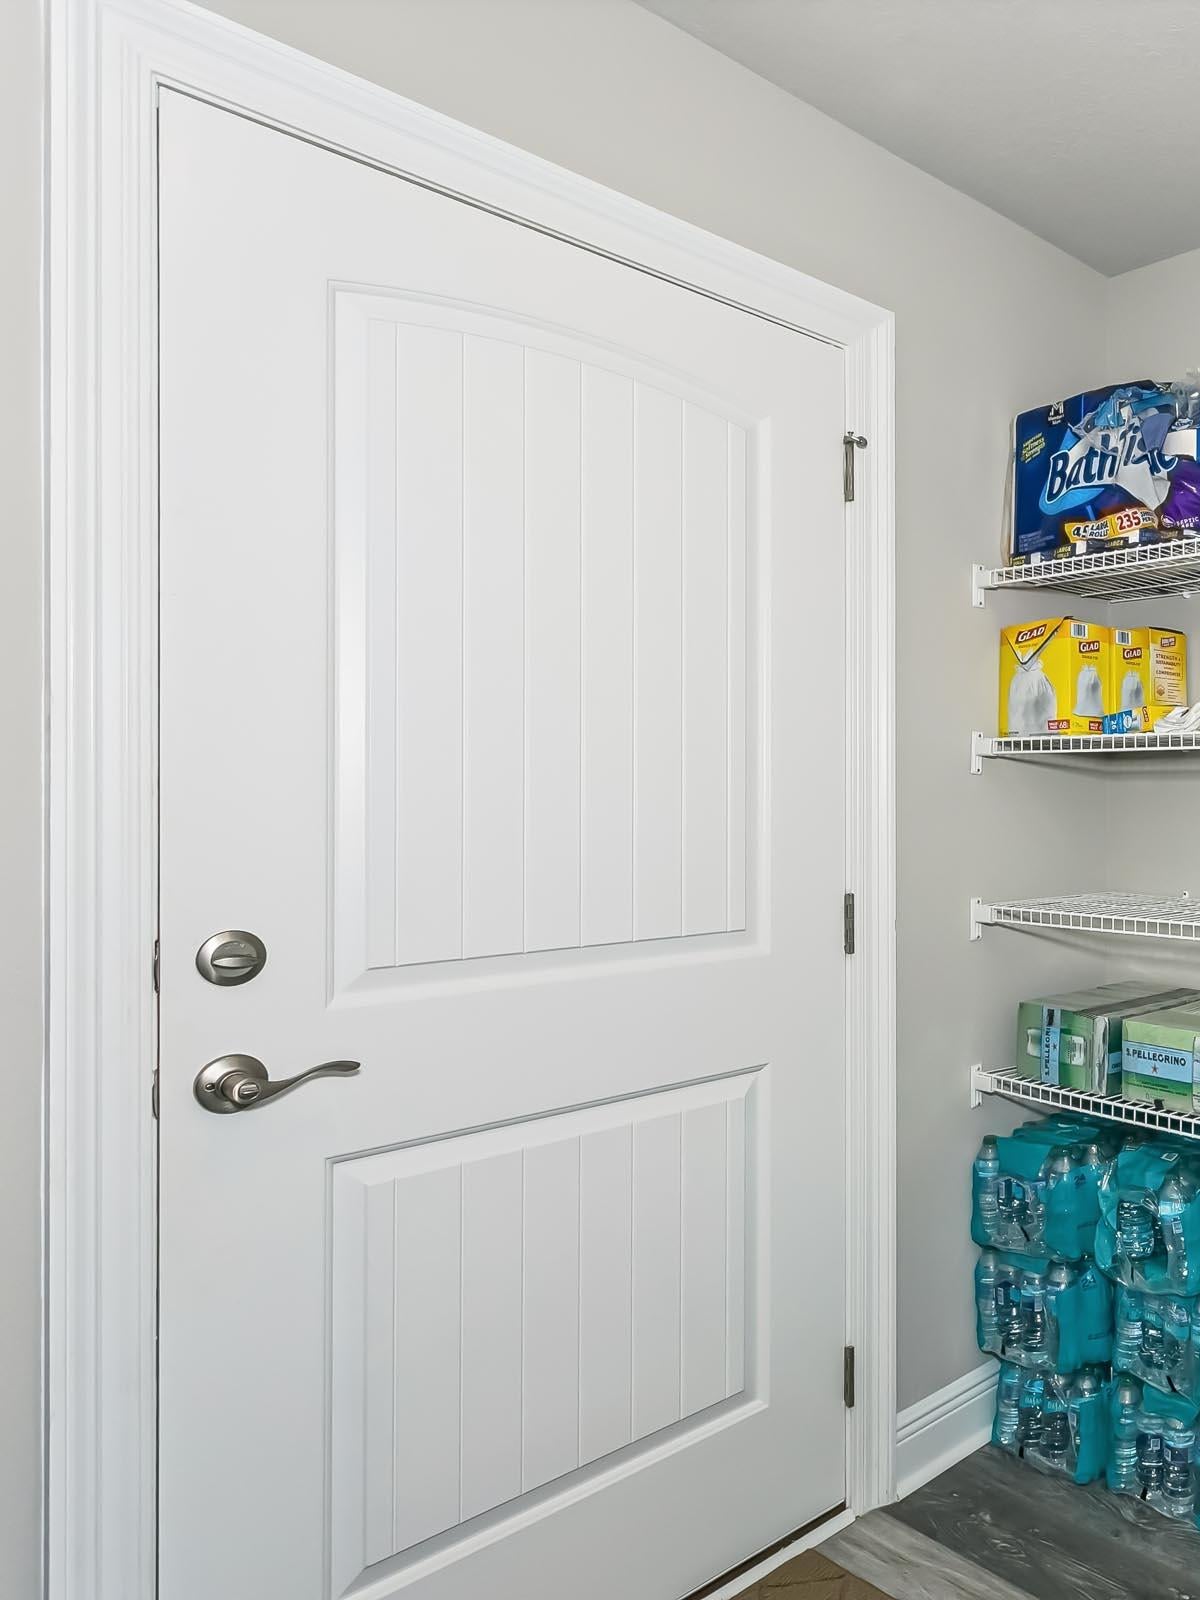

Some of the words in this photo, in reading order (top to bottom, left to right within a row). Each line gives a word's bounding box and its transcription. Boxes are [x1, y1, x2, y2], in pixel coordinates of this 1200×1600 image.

[1116, 510, 1142, 531] 235
[1017, 626, 1045, 642] GLAD
[1080, 642, 1099, 652] GLAD
[1124, 649, 1142, 659] GLAD
